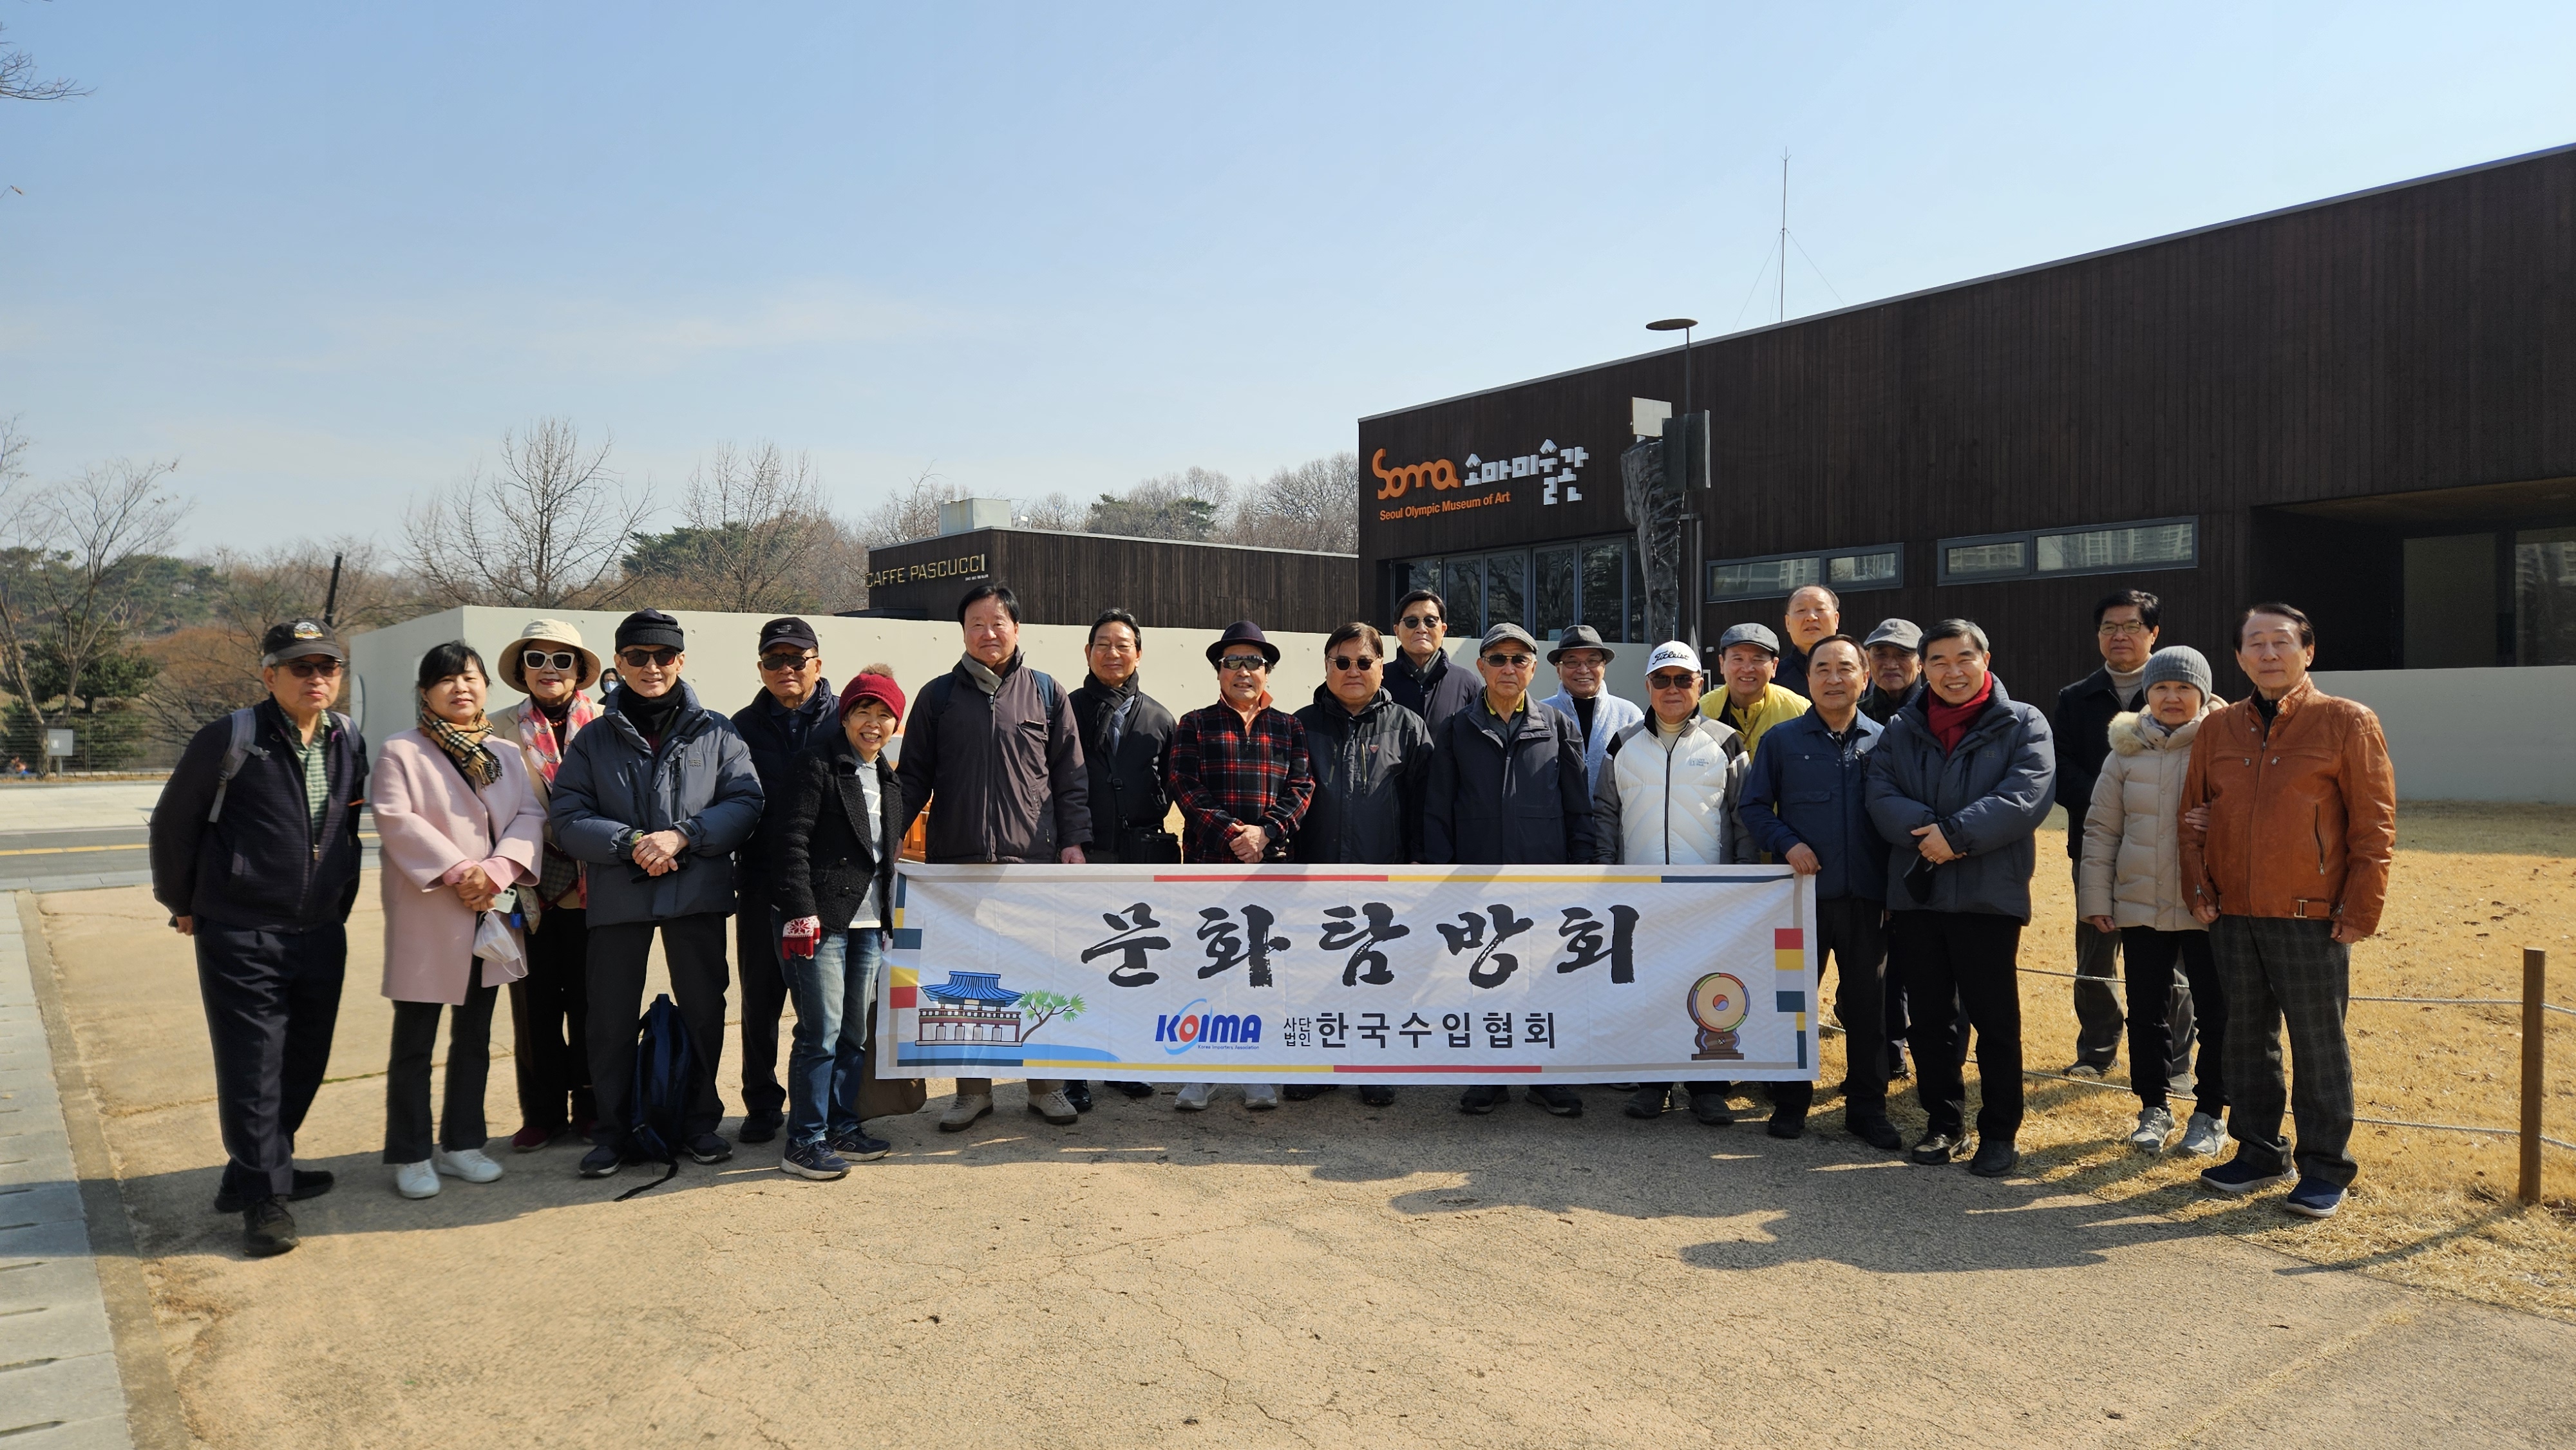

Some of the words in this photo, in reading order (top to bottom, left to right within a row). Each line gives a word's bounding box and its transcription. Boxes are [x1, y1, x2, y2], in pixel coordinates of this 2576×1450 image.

[1464, 438, 1589, 505] 소마미술관
[1379, 507, 1403, 521] Seoul
[1405, 502, 1440, 518] Olympic
[1442, 497, 1481, 513] Museum
[1482, 493, 1493, 505] of
[1495, 491, 1511, 504] Art
[866, 567, 905, 588] CAFFE
[910, 554, 985, 581] PASCUCCI
[1652, 650, 1690, 665] Titleist
[1080, 902, 1640, 988] 문화탐방회
[1155, 1014, 1262, 1043] KOIMA
[1283, 1017, 1312, 1031] 사단
[1316, 1012, 1555, 1049] 한국수입협회
[1283, 1032, 1311, 1047] 법인
